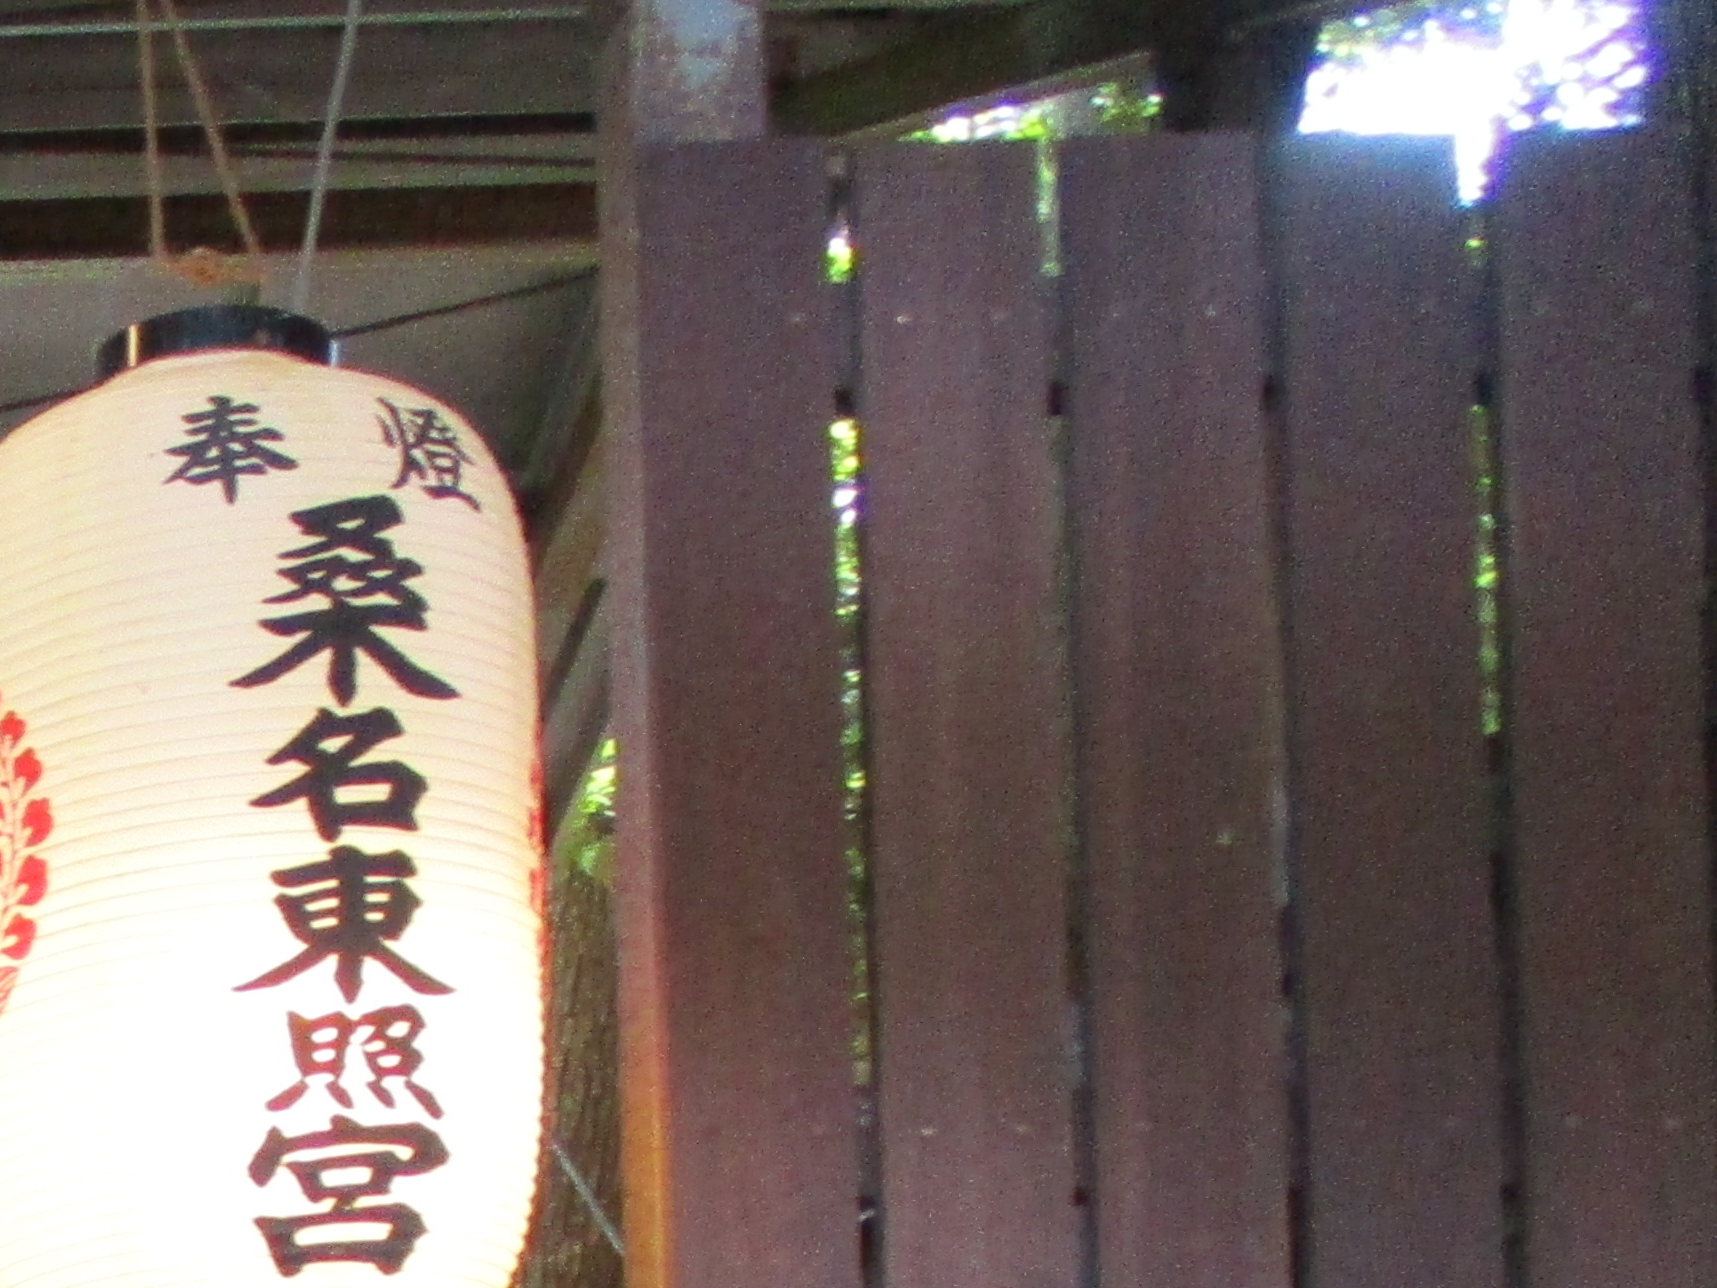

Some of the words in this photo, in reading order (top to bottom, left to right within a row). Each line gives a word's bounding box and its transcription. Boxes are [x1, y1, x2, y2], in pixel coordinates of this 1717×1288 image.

[228, 494, 463, 1277] 桑名東照宮
